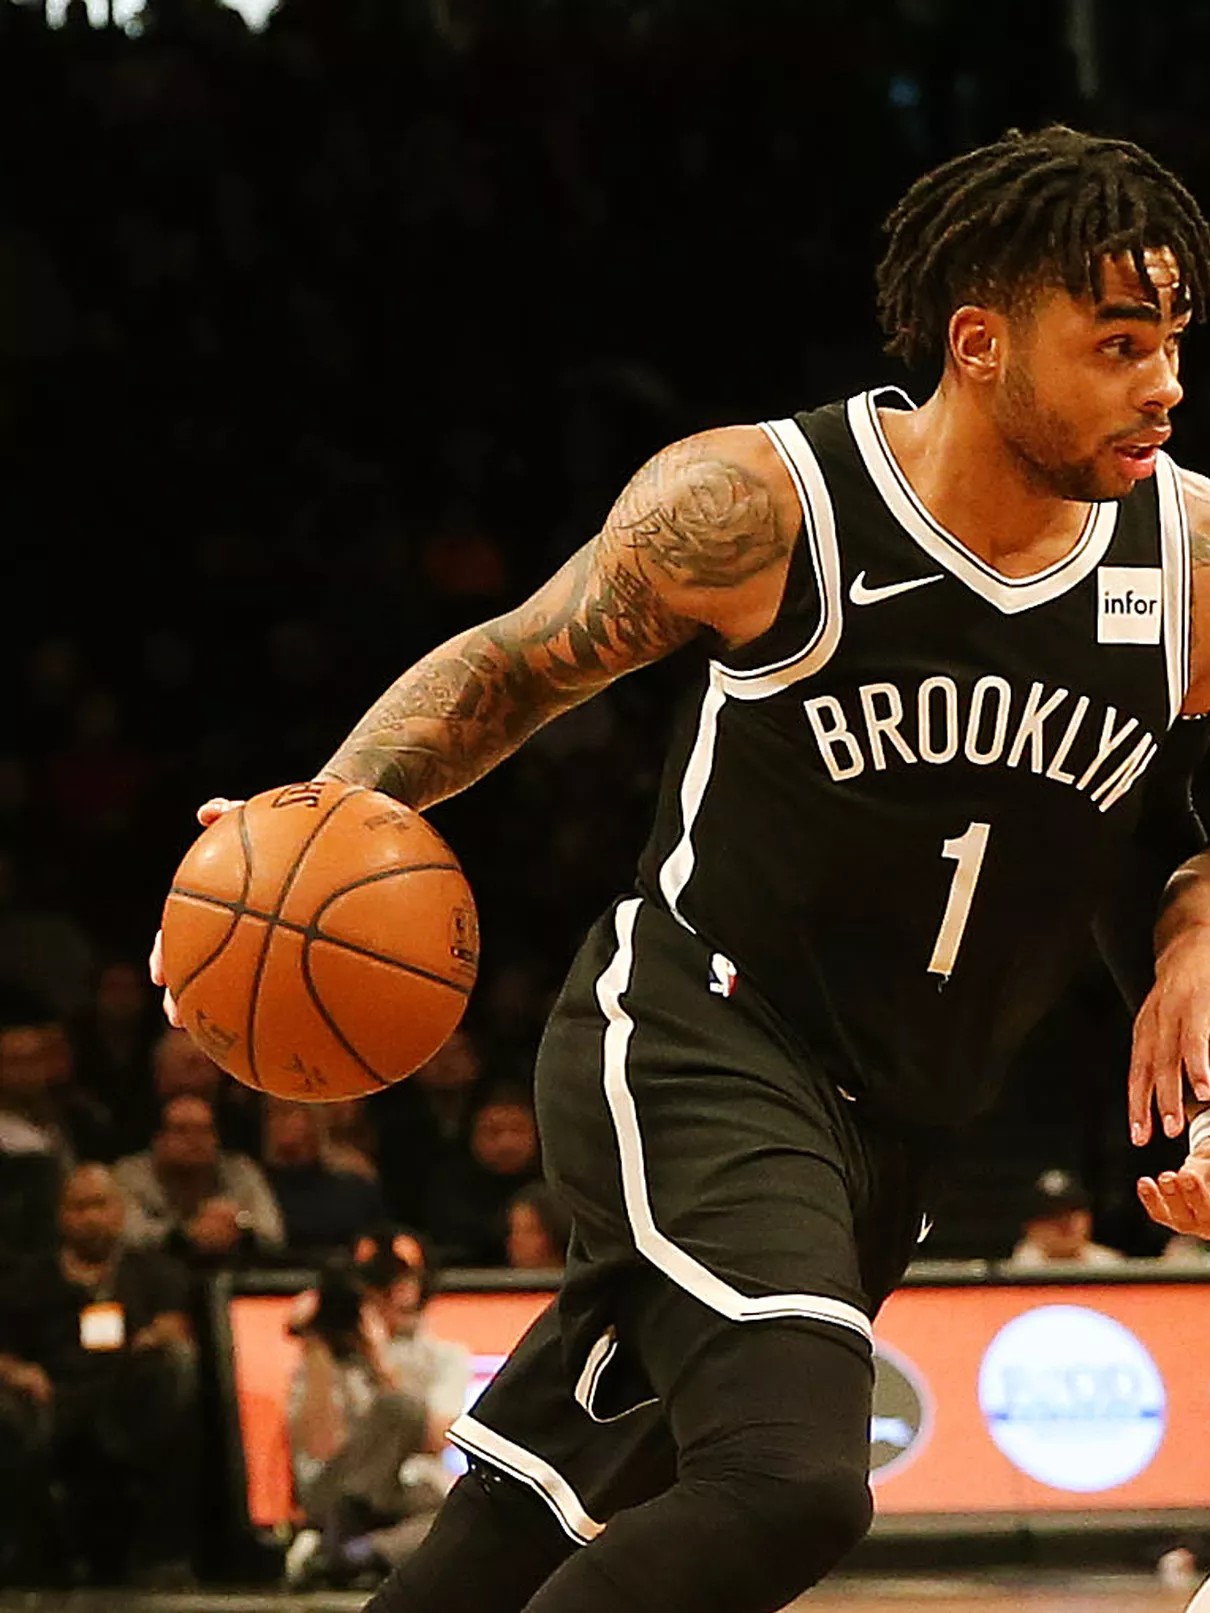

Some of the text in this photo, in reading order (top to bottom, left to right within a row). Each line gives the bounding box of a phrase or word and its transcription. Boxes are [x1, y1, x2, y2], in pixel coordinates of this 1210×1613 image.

[1104, 590, 1158, 615] infor
[803, 676, 1158, 813] BROOKLYN
[927, 821, 991, 976] 1
